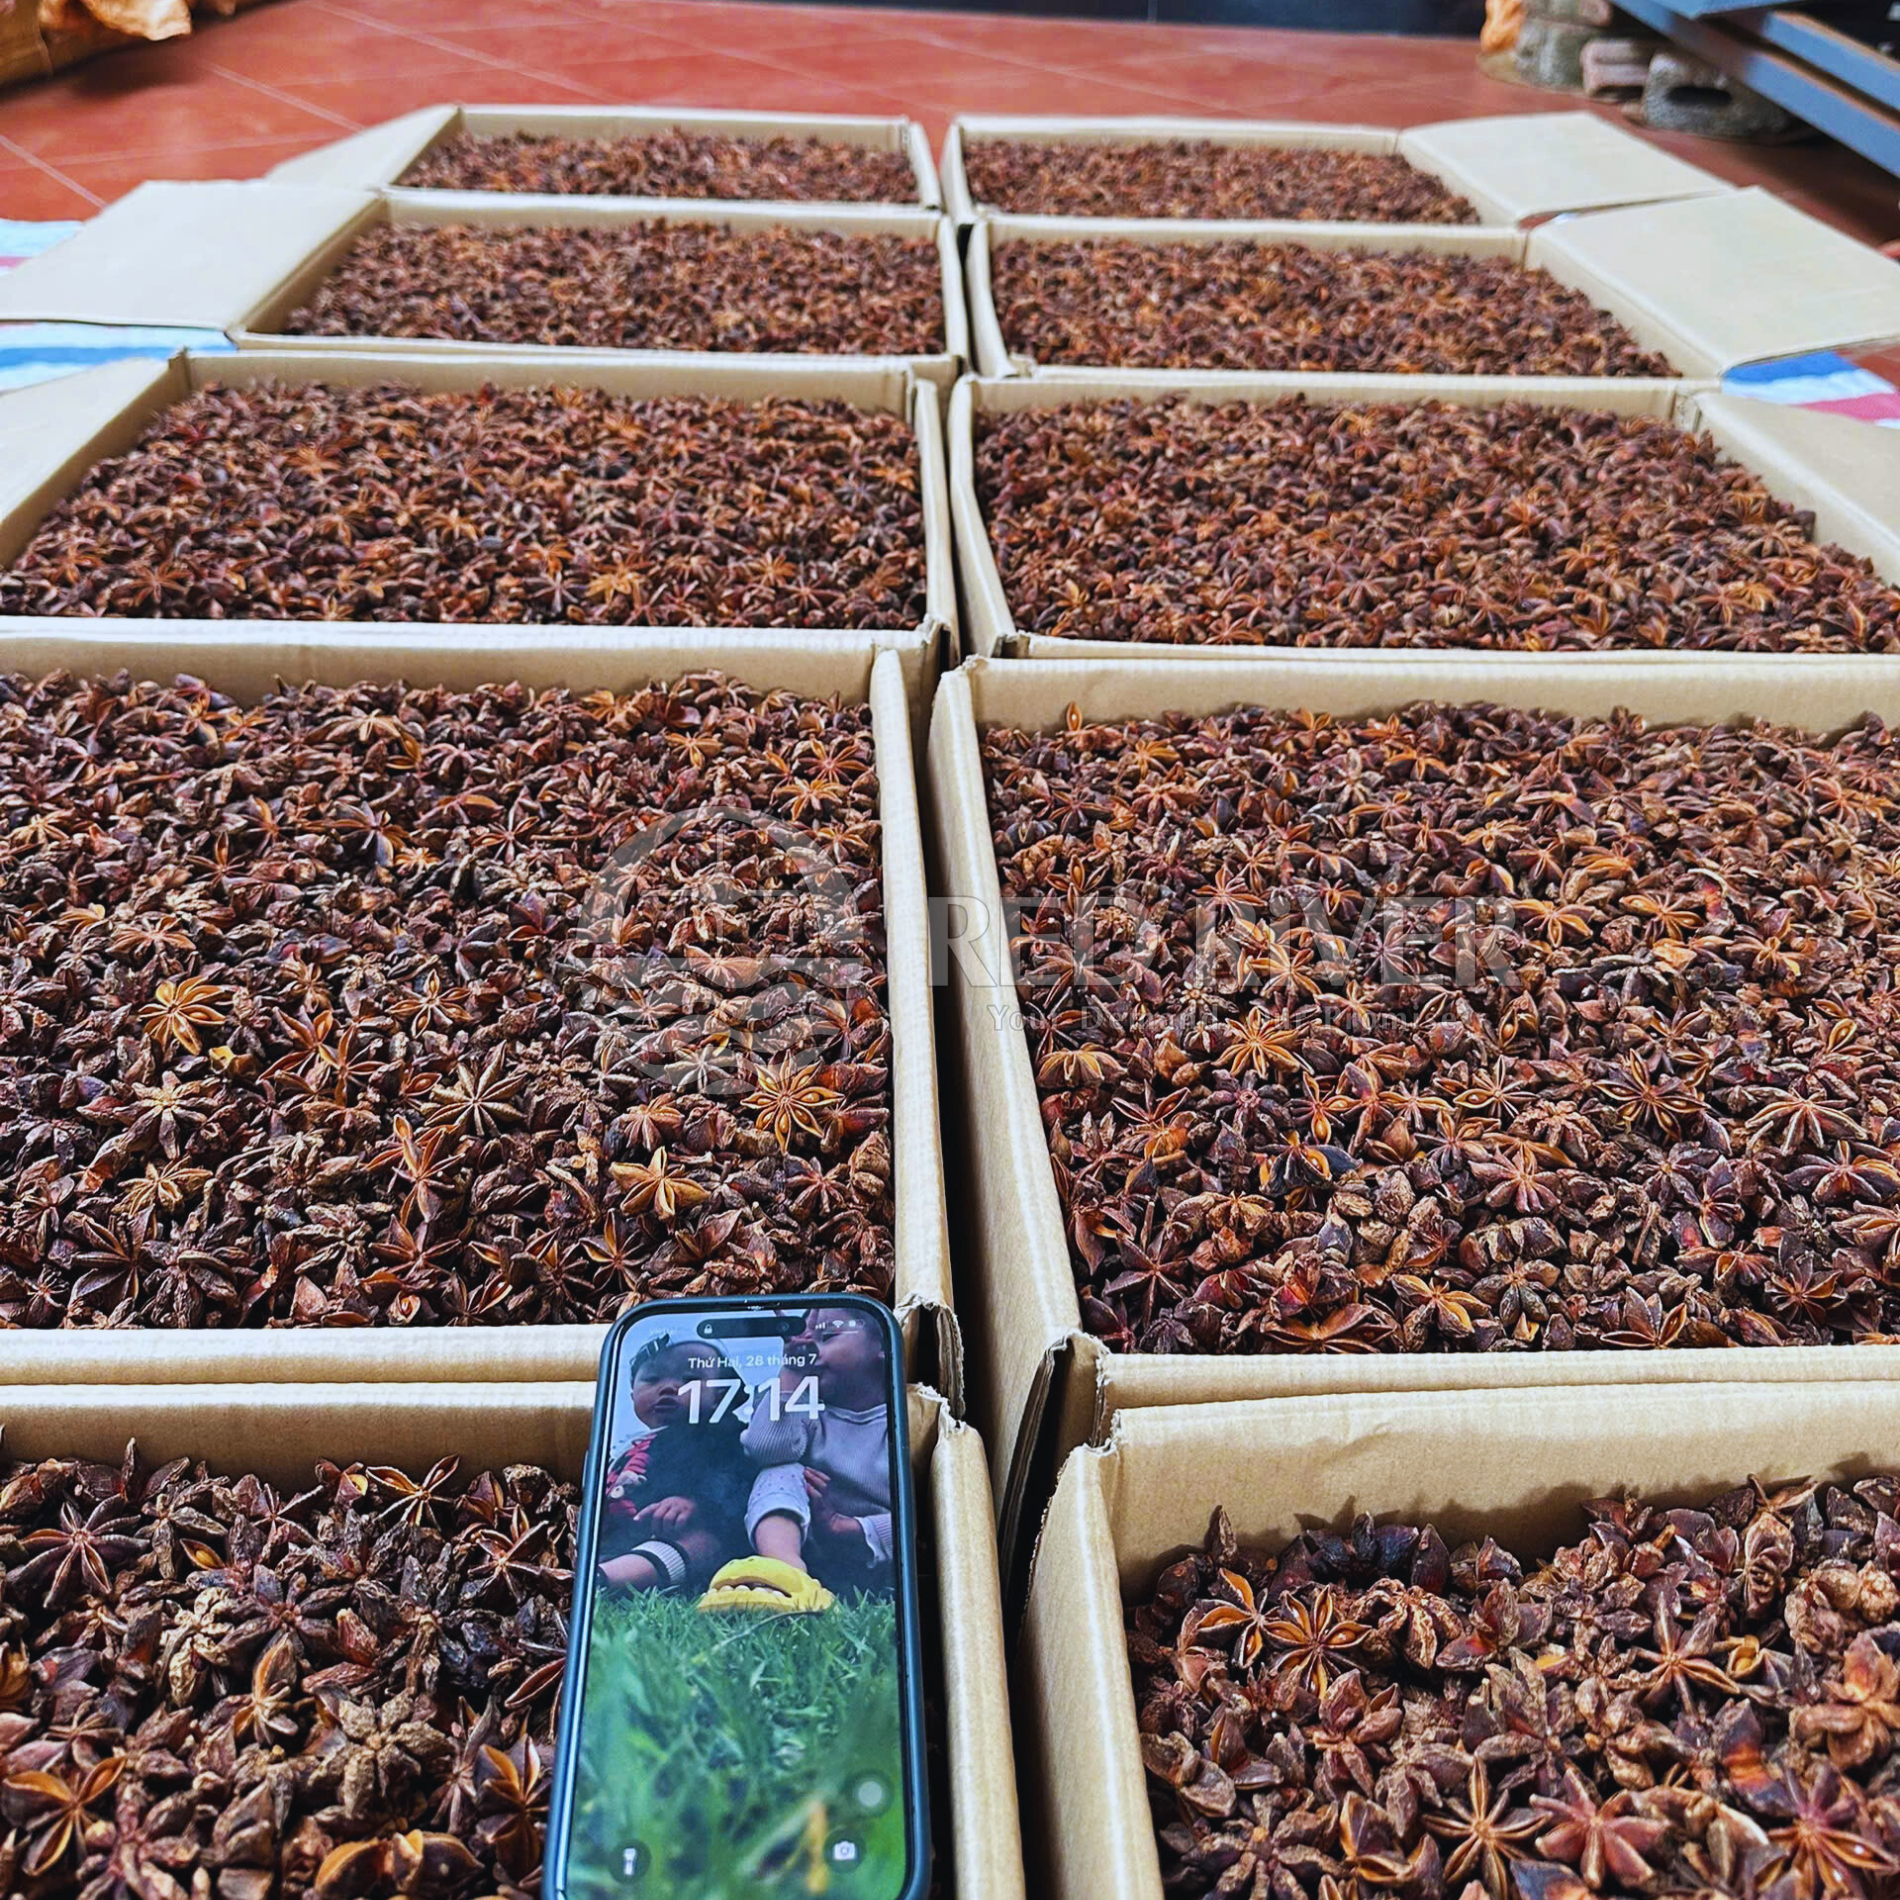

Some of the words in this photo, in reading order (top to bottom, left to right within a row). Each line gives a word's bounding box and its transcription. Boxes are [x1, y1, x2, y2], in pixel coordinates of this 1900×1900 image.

[687, 1355, 715, 1369] Thứ
[717, 1357, 743, 1369] Hai,
[745, 1355, 764, 1366] 28
[767, 1354, 805, 1368] tháng
[808, 1353, 818, 1365] 7
[677, 1375, 826, 1425] 17:14
